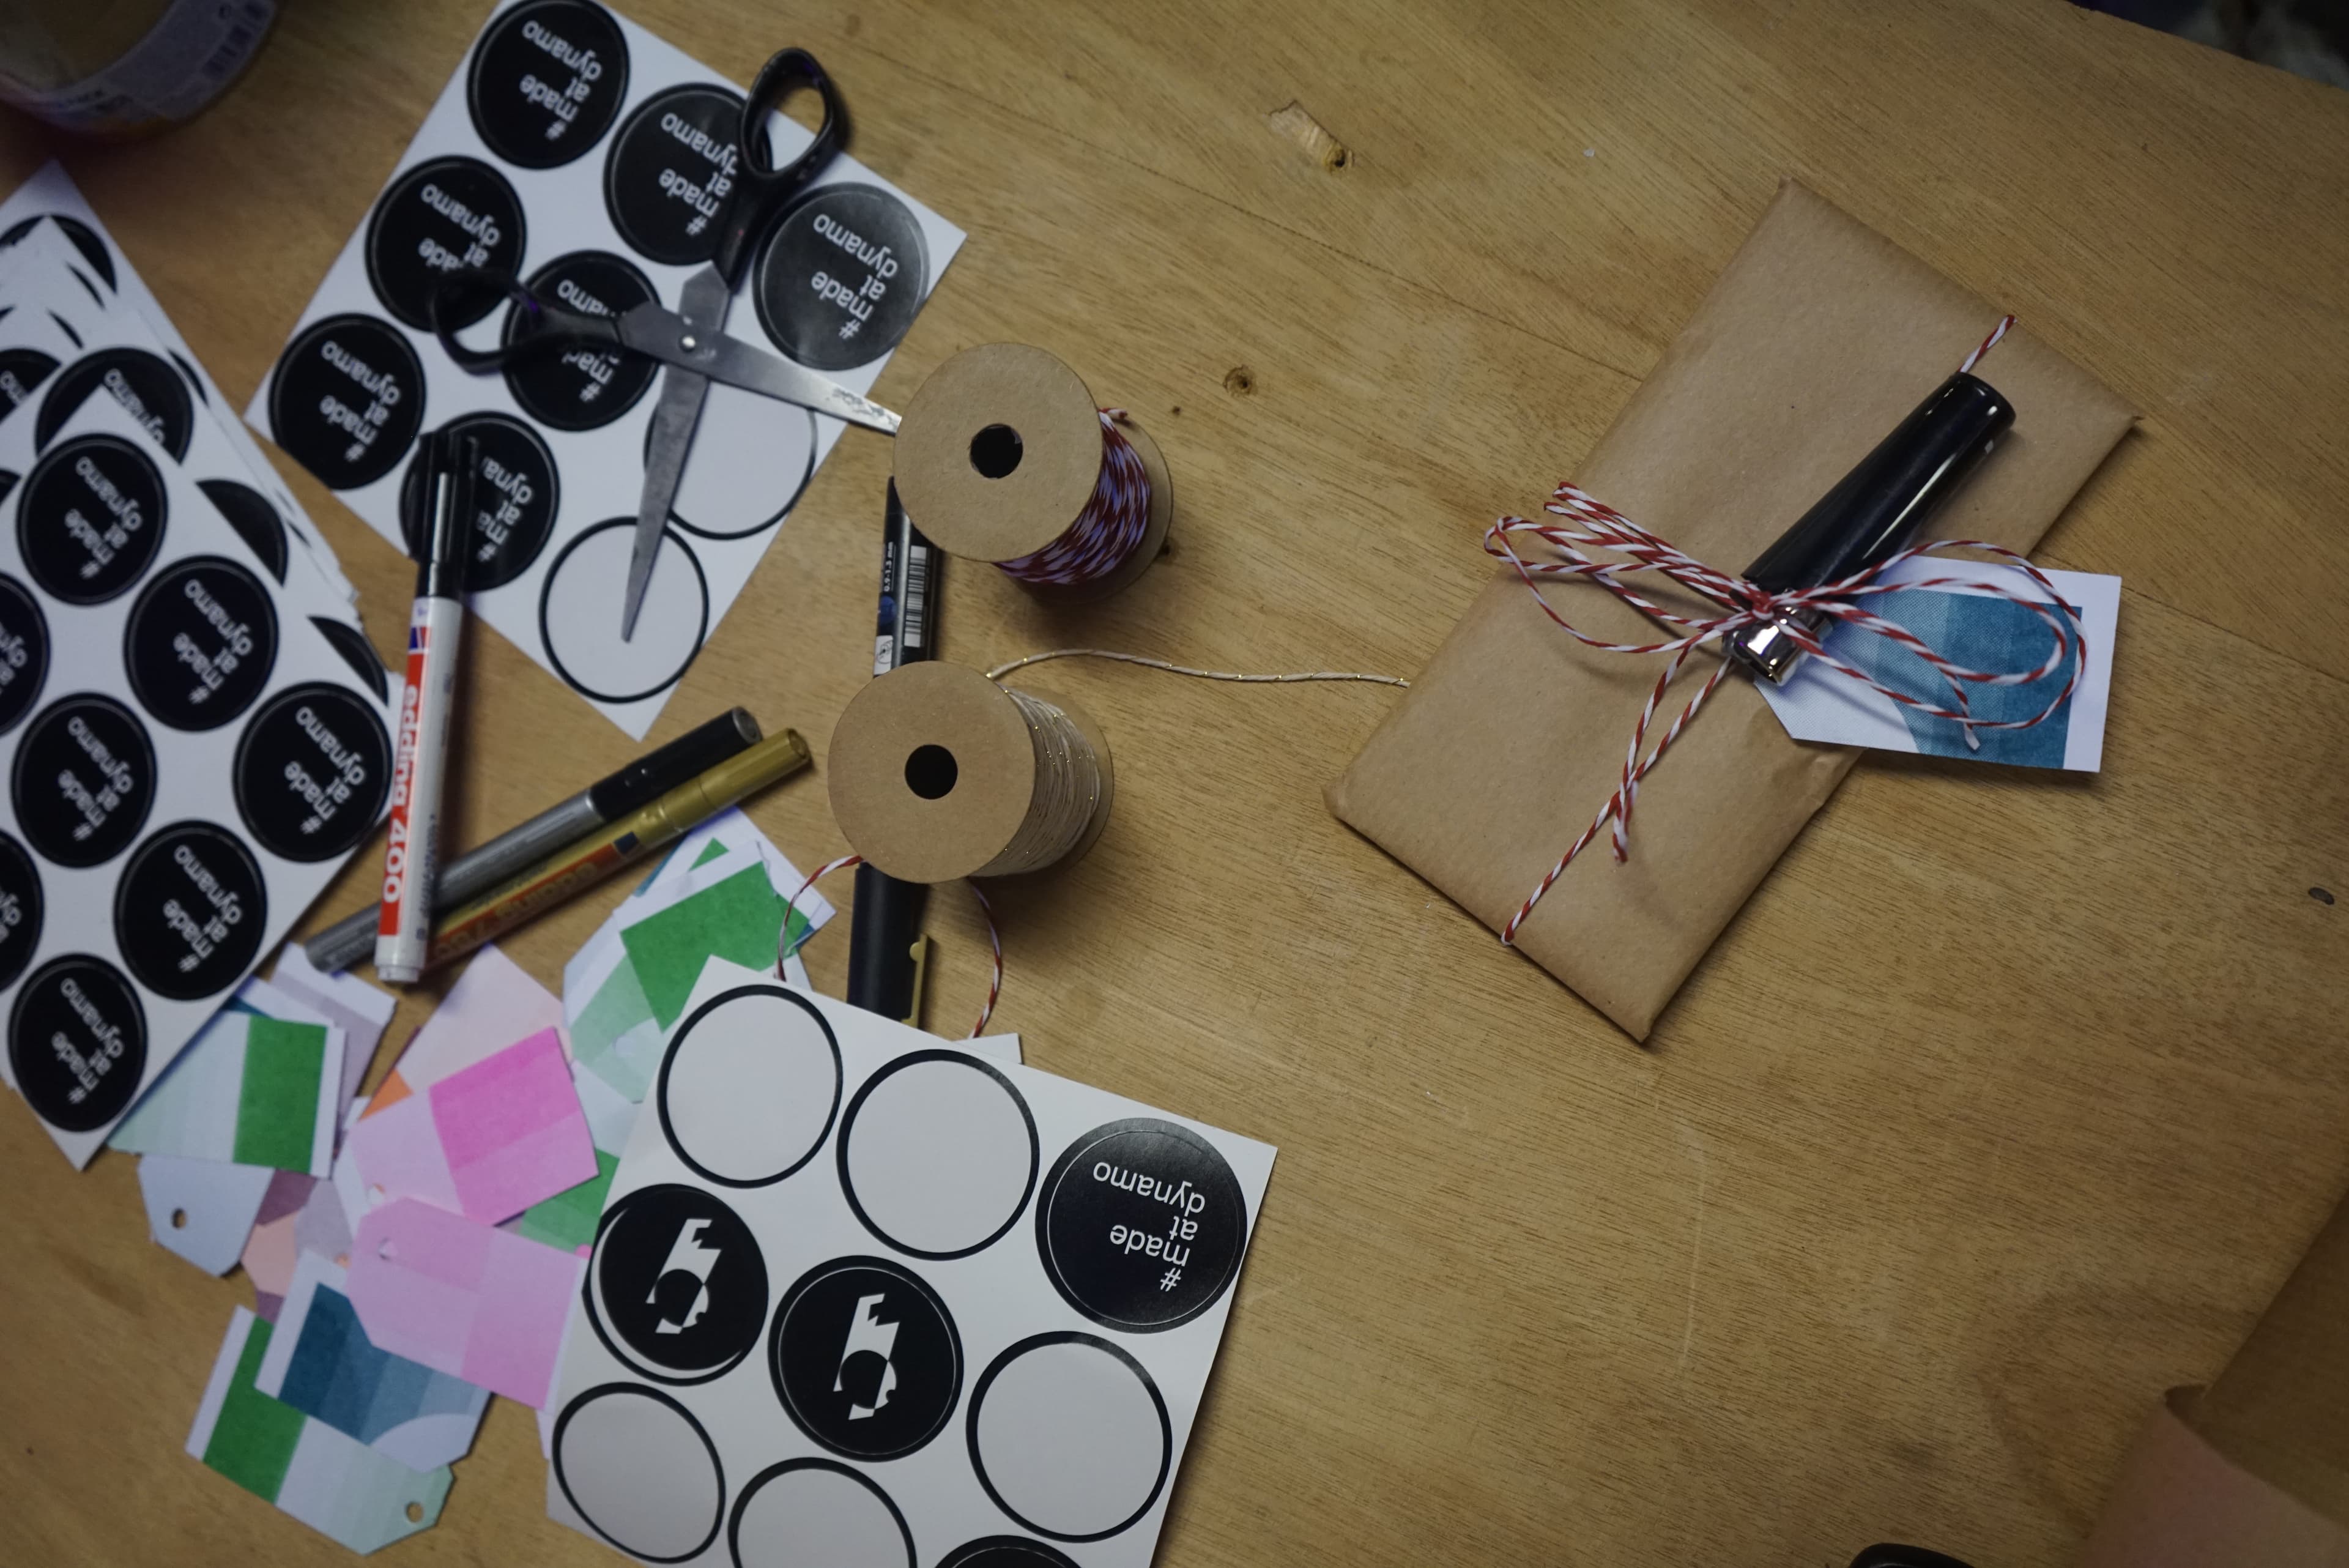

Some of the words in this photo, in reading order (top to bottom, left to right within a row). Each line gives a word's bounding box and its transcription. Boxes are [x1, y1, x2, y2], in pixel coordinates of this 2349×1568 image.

[522, 20, 603, 82] dynamo
[519, 75, 579, 121] made
[566, 77, 590, 102] at
[658, 168, 719, 218] made
[705, 171, 732, 197] at
[420, 184, 500, 247] dynamo
[418, 238, 462, 271] ade
[467, 241, 489, 267] at
[813, 214, 899, 278] dynamo
[811, 272, 874, 322] made
[859, 274, 886, 301] at
[840, 321, 859, 338] #
[321, 341, 401, 406] dynamo
[319, 395, 378, 445] made
[365, 401, 390, 426] at
[75, 456, 143, 531] dynamo
[481, 456, 533, 505] dyna
[64, 509, 115, 565] made
[103, 521, 128, 548] at
[475, 511, 509, 545] ma
[496, 500, 521, 526] at
[185, 579, 253, 656] dynamo
[173, 633, 224, 691] made
[212, 647, 239, 675] at
[68, 716, 133, 794] dynamo
[295, 706, 365, 786] dynamo
[392, 685, 418, 807] edding
[58, 770, 106, 828] made
[95, 786, 120, 811] at
[284, 760, 336, 822] made
[324, 778, 352, 805] at
[174, 845, 242, 924] dynamo
[384, 816, 408, 904] 400
[163, 899, 215, 959] made
[203, 916, 229, 943] at
[61, 978, 125, 1058] dynamo
[51, 1031, 99, 1091] made
[89, 1048, 112, 1076] at
[1093, 1162, 1205, 1217] dynamo
[1110, 1225, 1190, 1267] made
[1169, 1215, 1198, 1241] at
[1160, 1268, 1180, 1291] #
